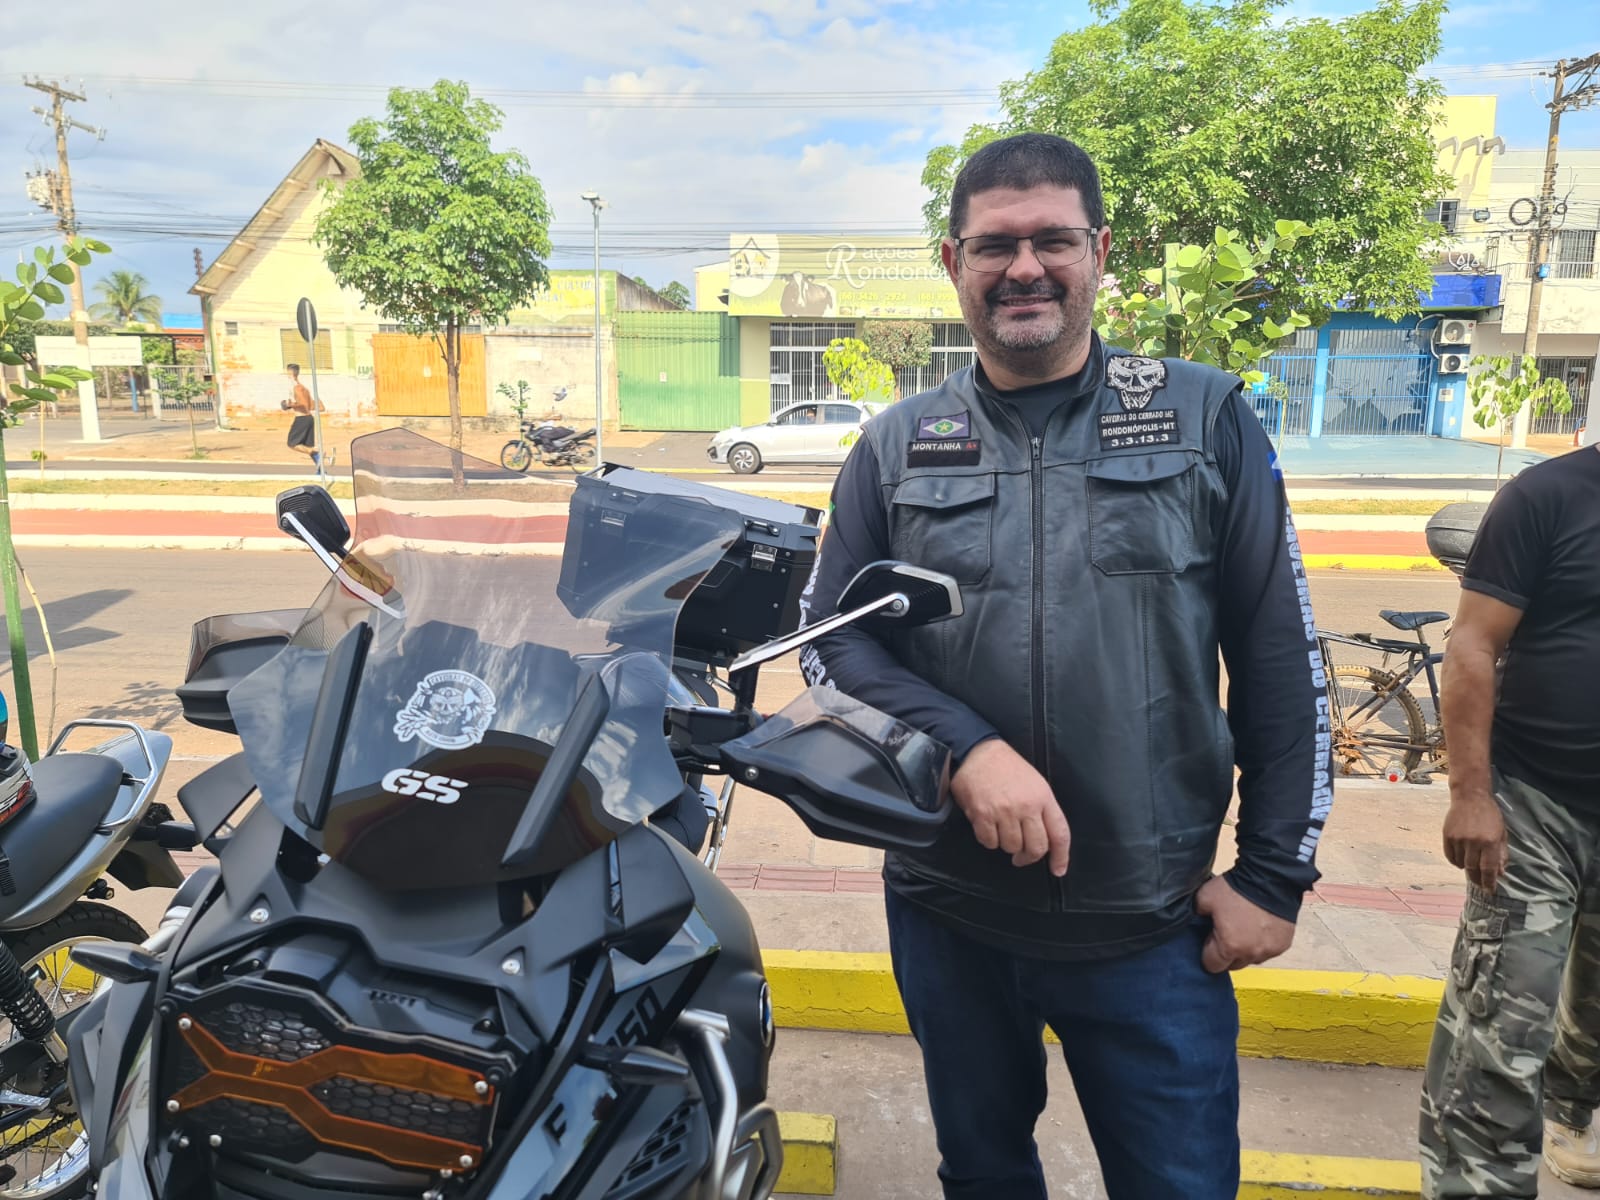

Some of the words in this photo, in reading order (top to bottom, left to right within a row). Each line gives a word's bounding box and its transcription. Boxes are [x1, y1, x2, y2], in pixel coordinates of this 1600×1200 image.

[1101, 413, 1127, 424] CAVEIRAS
[1128, 412, 1137, 421] DO
[1138, 411, 1164, 420] CERRADO
[1164, 410, 1174, 418] MC
[1102, 422, 1175, 437] RONDONÓPOLIS-MT
[912, 442, 961, 451] MONTANHA
[1111, 433, 1169, 447] 3.3.13.3
[381, 768, 469, 804] GS
